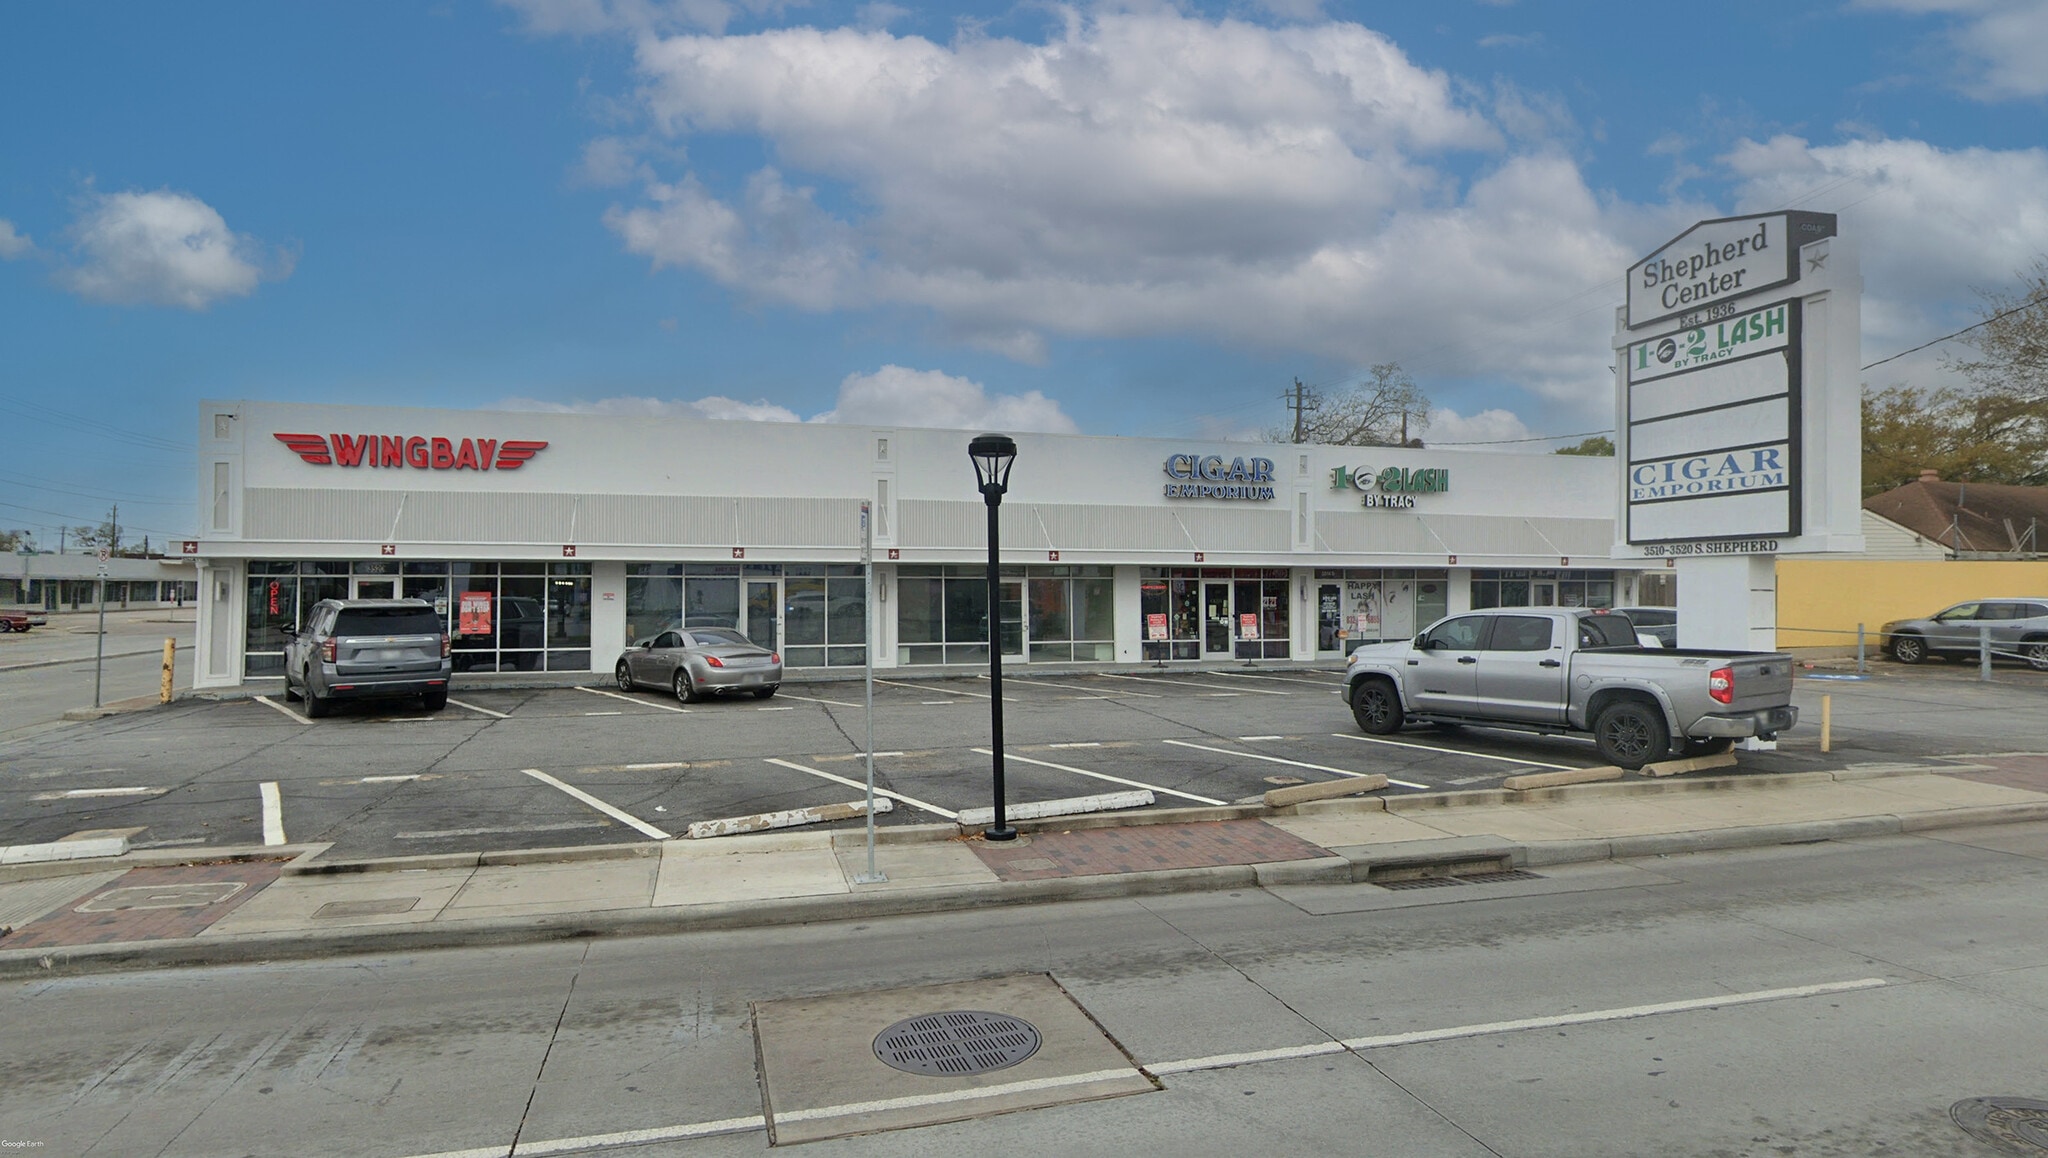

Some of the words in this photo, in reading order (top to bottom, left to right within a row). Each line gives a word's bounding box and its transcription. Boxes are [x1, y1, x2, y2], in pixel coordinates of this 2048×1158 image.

[1643, 222, 1768, 289] Shepherd
[1661, 268, 1747, 309] Center
[1679, 314, 1702, 329] Est.
[1706, 302, 1736, 321] 1936
[1718, 307, 1785, 349] LASH
[1674, 358, 1689, 368] BY
[1694, 347, 1734, 363] TRACY
[330, 433, 497, 470] WINGBAY
[1166, 453, 1276, 482] CIGAR
[1402, 467, 1449, 492] LASH
[1633, 449, 1783, 486] CIGAR
[1165, 484, 1276, 500] EMPORIUM
[1632, 473, 1784, 499] EMPORIUM
[1365, 494, 1381, 508] BY
[1383, 495, 1418, 508] TRACY
[1644, 545, 1693, 556] 3510-3520
[1694, 543, 1704, 554] S.
[1706, 540, 1778, 553] SHEPHERD
[269, 581, 280, 615] OPEN
[1347, 582, 1377, 590] HAPPY
[1351, 592, 1375, 600] LASH
